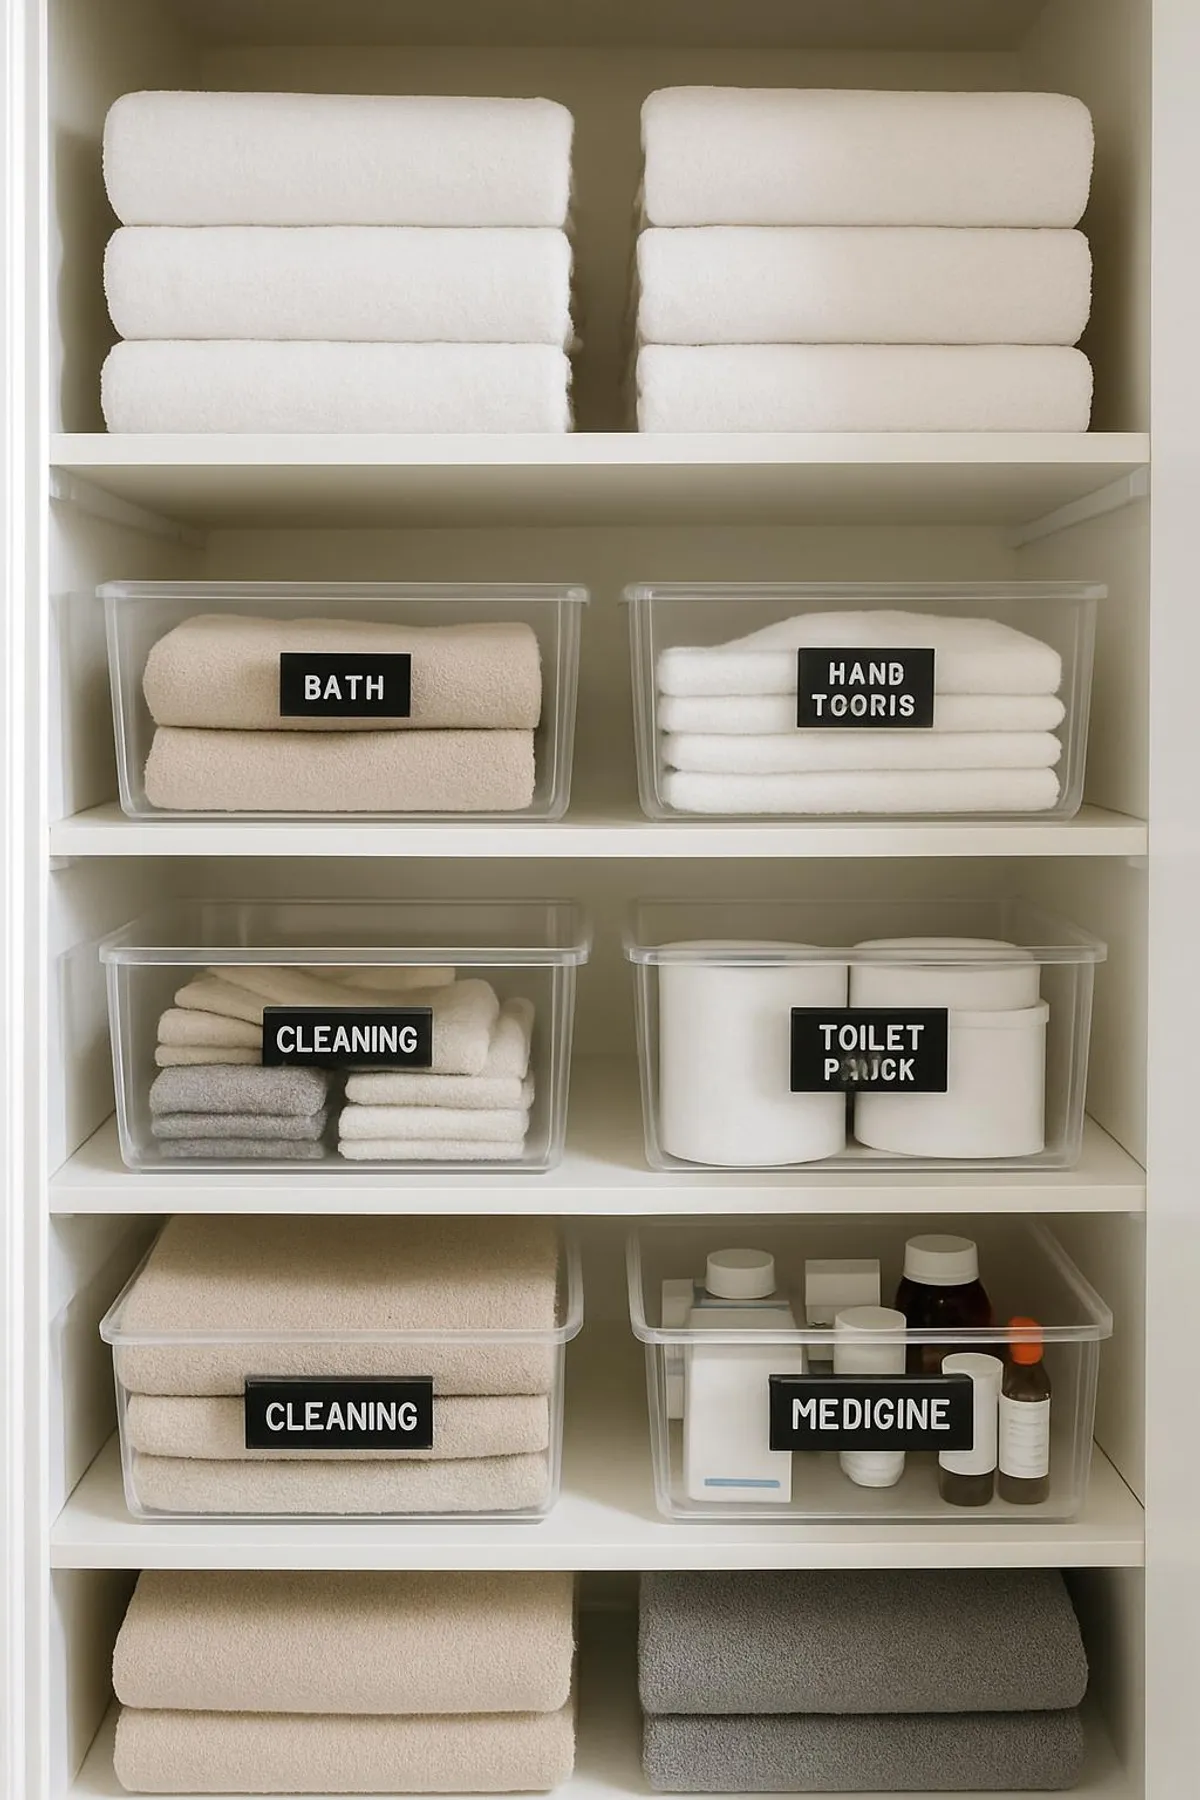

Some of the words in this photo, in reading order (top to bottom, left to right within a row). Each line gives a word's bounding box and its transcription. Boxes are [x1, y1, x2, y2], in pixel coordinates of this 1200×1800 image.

[304, 674, 384, 701] BATH
[829, 661, 904, 686] HAND
[276, 1025, 418, 1054] CLEANING
[818, 1024, 925, 1051] TOILET
[265, 1401, 418, 1431] CLEANING
[792, 1398, 951, 1430] MEDIGINE
